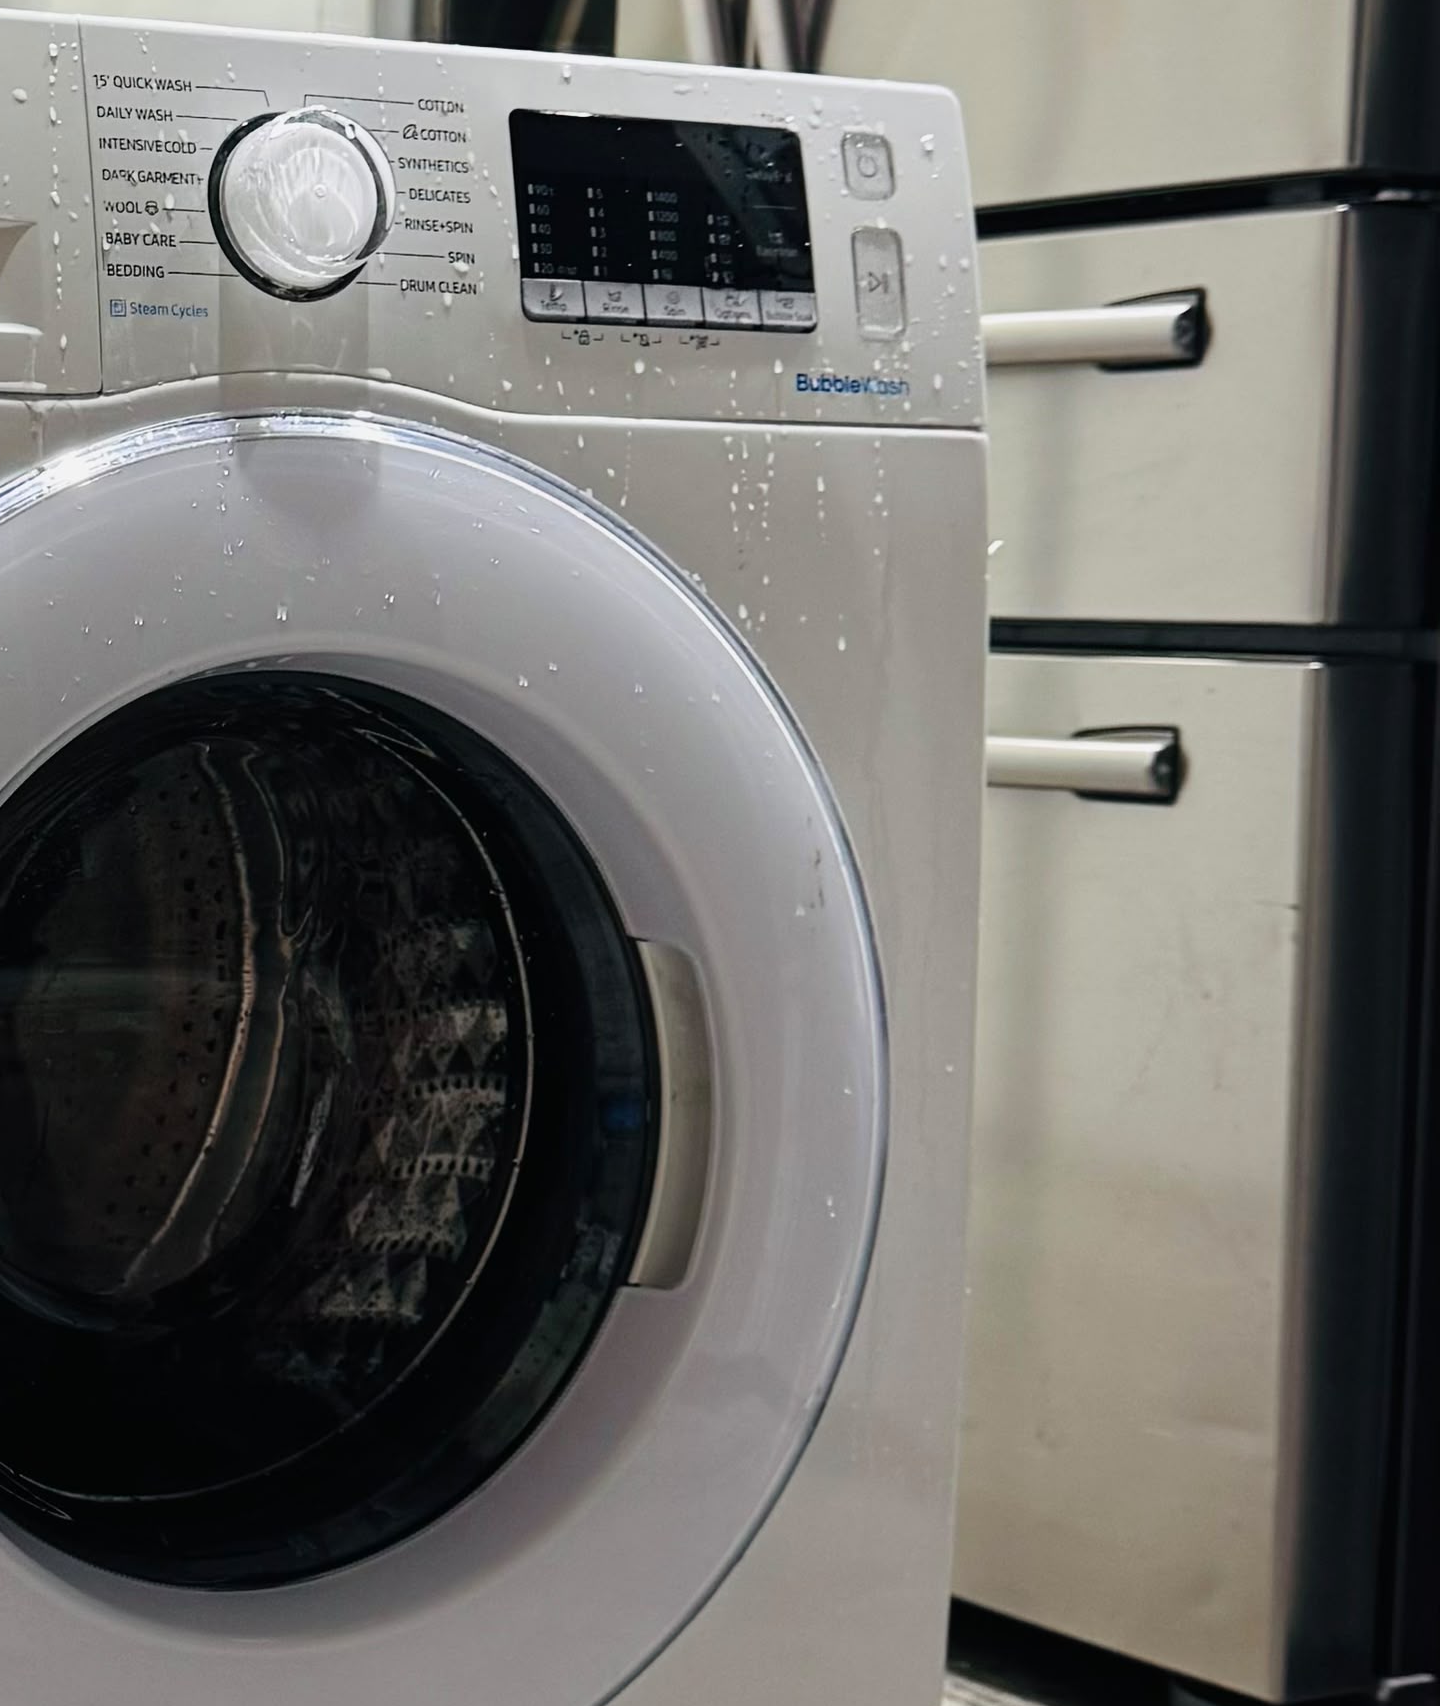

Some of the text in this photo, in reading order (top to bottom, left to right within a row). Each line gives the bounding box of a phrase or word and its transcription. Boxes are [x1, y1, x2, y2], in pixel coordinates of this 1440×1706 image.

[113, 75, 153, 90] QUICK
[154, 78, 192, 92] WASH
[96, 105, 173, 122] DAILY WASH
[417, 98, 465, 114] COTTON
[420, 128, 467, 143] COTTON
[98, 137, 197, 155] INTENSIVE COLD
[398, 156, 469, 174] SYNTHETICS
[102, 168, 136, 183] DARK
[408, 187, 471, 204] DELICATES
[103, 200, 143, 214] WOOL
[404, 217, 474, 234] RINSE+SPIN
[105, 232, 177, 247] BABY CARE
[448, 251, 475, 265] SPIN
[107, 263, 165, 279] BEDDING
[400, 278, 477, 296] DRUM CLEAN
[129, 301, 209, 319] Steam Cycles
